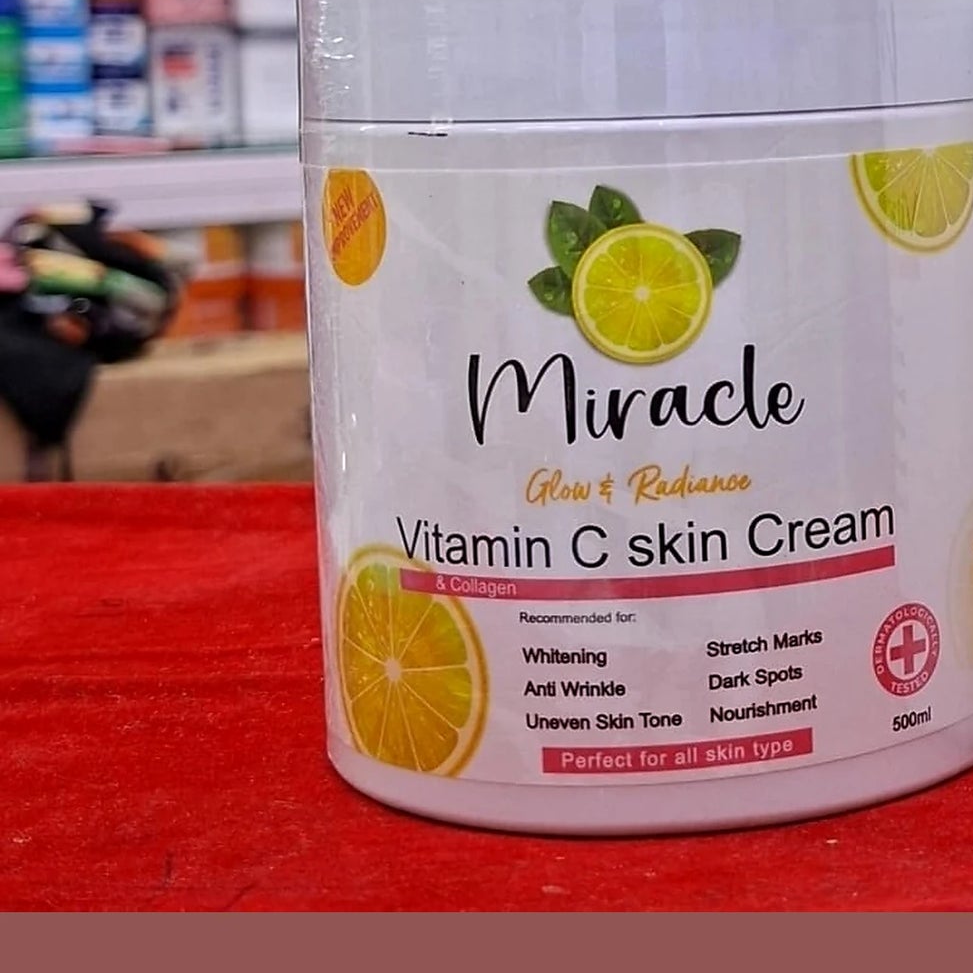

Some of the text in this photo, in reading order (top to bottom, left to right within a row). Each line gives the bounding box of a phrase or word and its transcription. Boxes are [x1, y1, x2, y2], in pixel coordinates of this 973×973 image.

[467, 344, 805, 446] Miracle
[526, 464, 752, 507] Glow & Radiance
[396, 503, 895, 570] Vitamin C skin Cream
[435, 575, 517, 598] & Collagen
[519, 611, 638, 624] Recommended for:
[706, 628, 823, 658] Stretch Marks
[522, 647, 607, 667] Whitening
[524, 680, 626, 697] Anti Wrinkle
[708, 664, 803, 690] Dark Spots
[891, 672, 930, 694] TESTED
[526, 711, 683, 731] Uneven Skin Tone
[710, 694, 818, 724] Nourishment
[892, 706, 932, 732] 500ml
[561, 736, 794, 769] Perfect for all skin type
